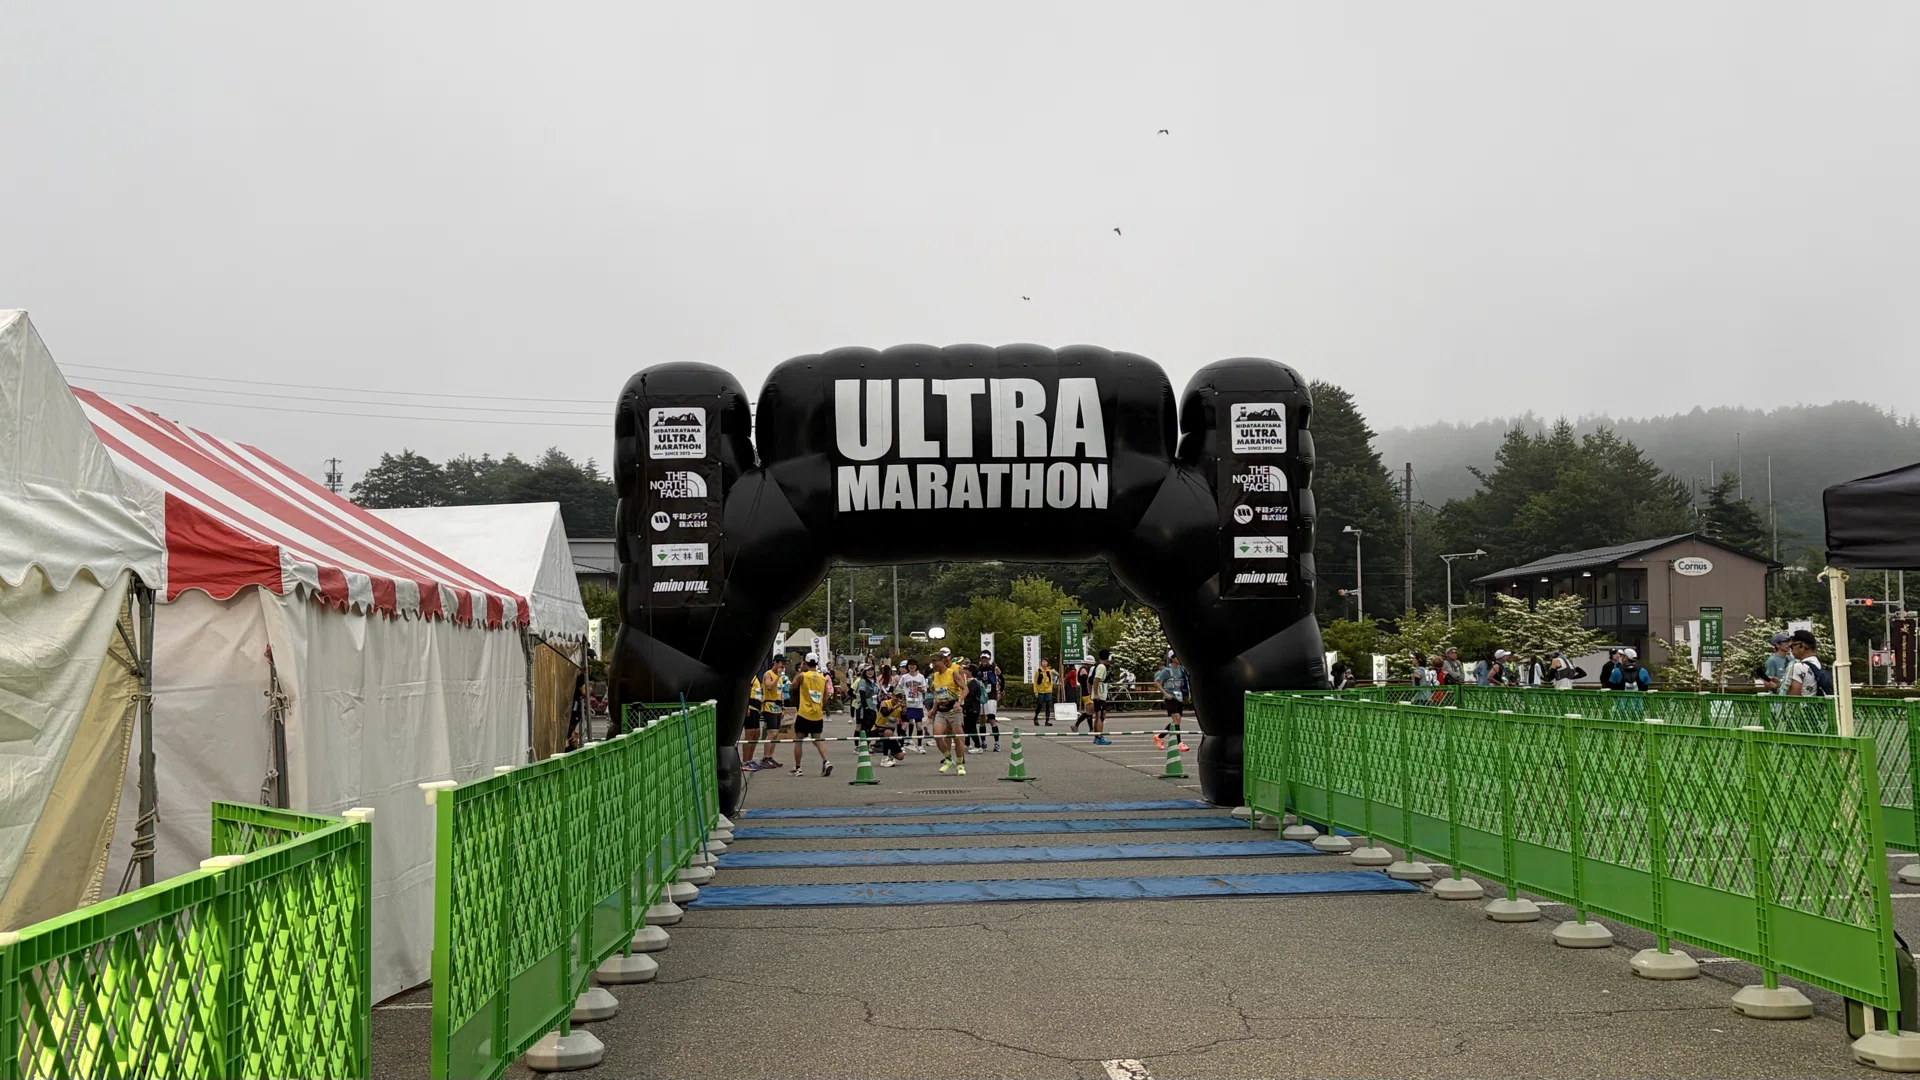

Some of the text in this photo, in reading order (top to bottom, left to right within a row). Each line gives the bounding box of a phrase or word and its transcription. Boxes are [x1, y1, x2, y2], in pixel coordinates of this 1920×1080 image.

[835, 377, 1107, 461] ULTRA
[1240, 429, 1278, 437] ULTRA
[658, 434, 696, 443] ULTRA
[1248, 465, 1269, 474] THE
[665, 471, 687, 480] THE
[1232, 474, 1269, 484] NORTH
[649, 480, 687, 490] NORTH
[837, 462, 1108, 512] MARATHON
[1243, 483, 1269, 492] FACE
[660, 489, 687, 498] FACE
[678, 520, 708, 528] 株式会社
[1253, 544, 1284, 553] 大林組
[671, 551, 704, 561] 大林組
[1678, 561, 1707, 570] Cornus
[1234, 570, 1288, 583] amino VITAL
[652, 578, 709, 592] amino VITAL
